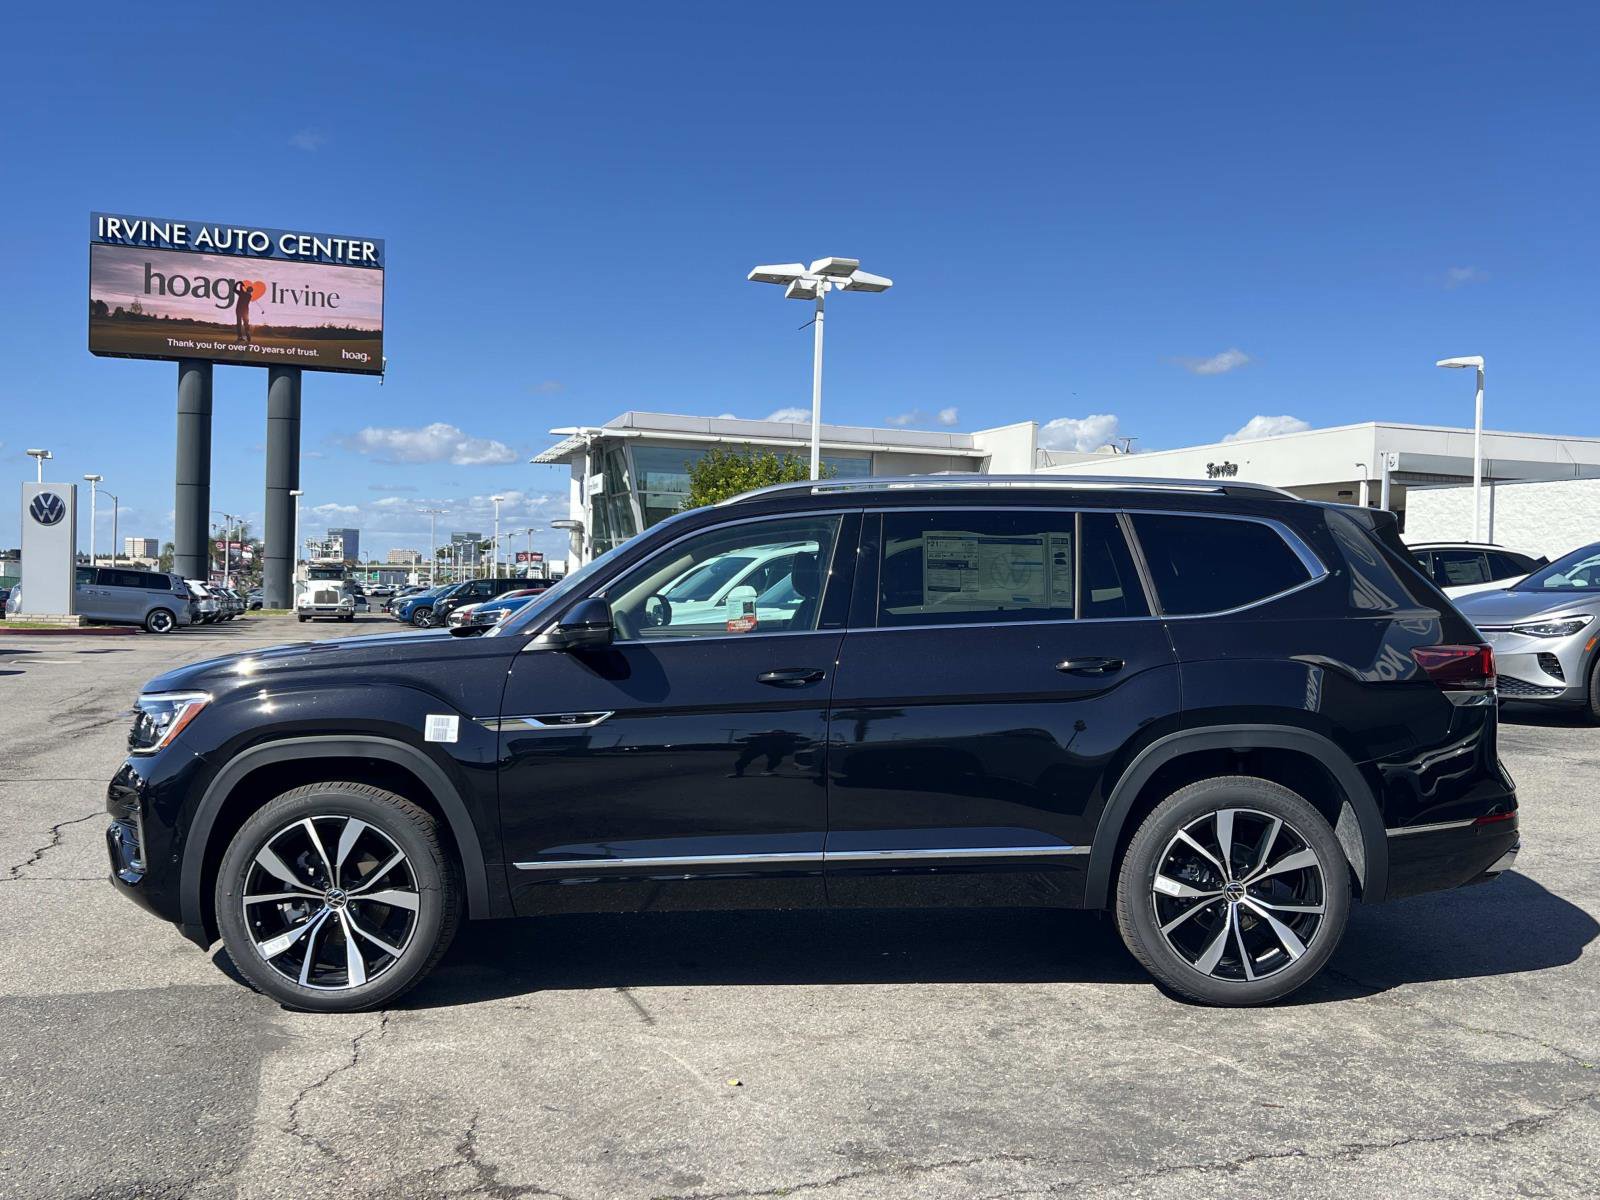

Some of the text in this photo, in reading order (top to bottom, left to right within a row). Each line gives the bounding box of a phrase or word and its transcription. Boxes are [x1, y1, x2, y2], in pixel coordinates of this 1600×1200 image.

[98, 216, 376, 261] IRVINE AUTO CENTER
[144, 262, 340, 309] hoag Irvine
[167, 338, 320, 356] Thank you for over 70 years of trust.
